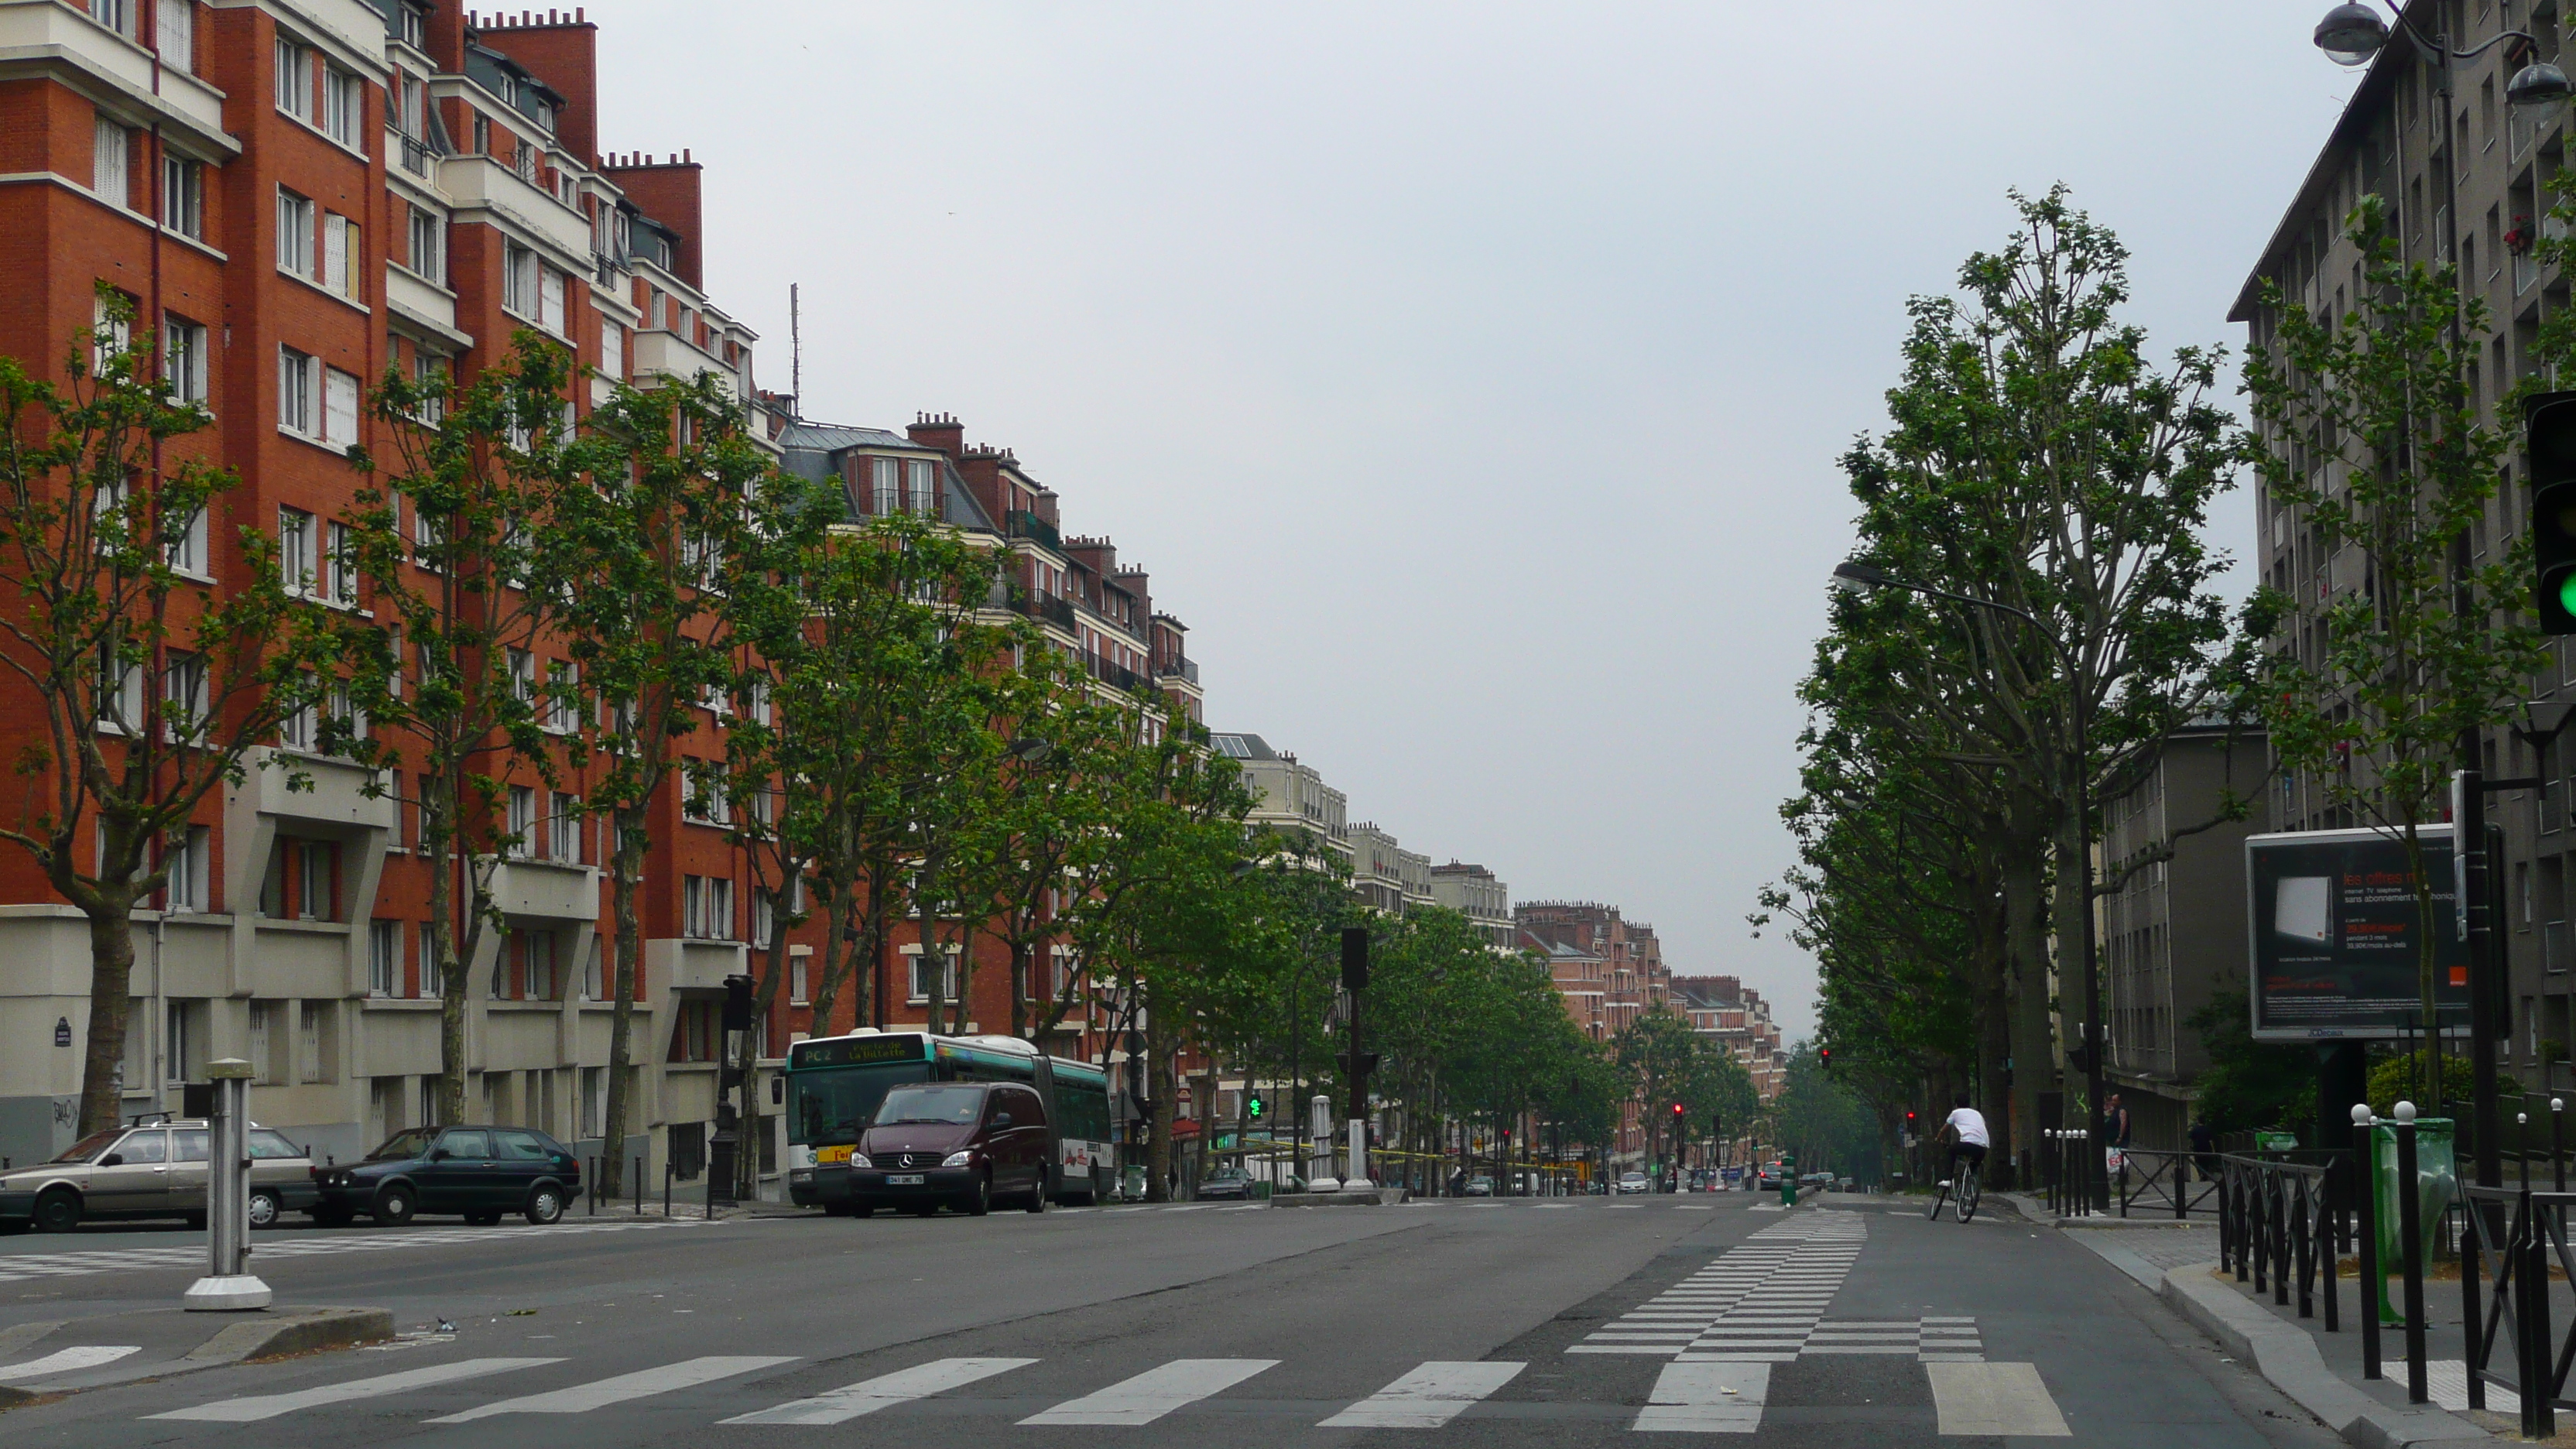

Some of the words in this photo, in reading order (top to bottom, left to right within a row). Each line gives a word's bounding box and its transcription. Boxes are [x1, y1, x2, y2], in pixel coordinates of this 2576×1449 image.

[2343, 872, 2362, 886] les
[2366, 871, 2403, 885] offres
[2364, 893, 2411, 903] abonnement
[2307, 1029, 2344, 1037] JCDecaux
[805, 1050, 822, 1062] PC
[824, 1050, 831, 1060] 2
